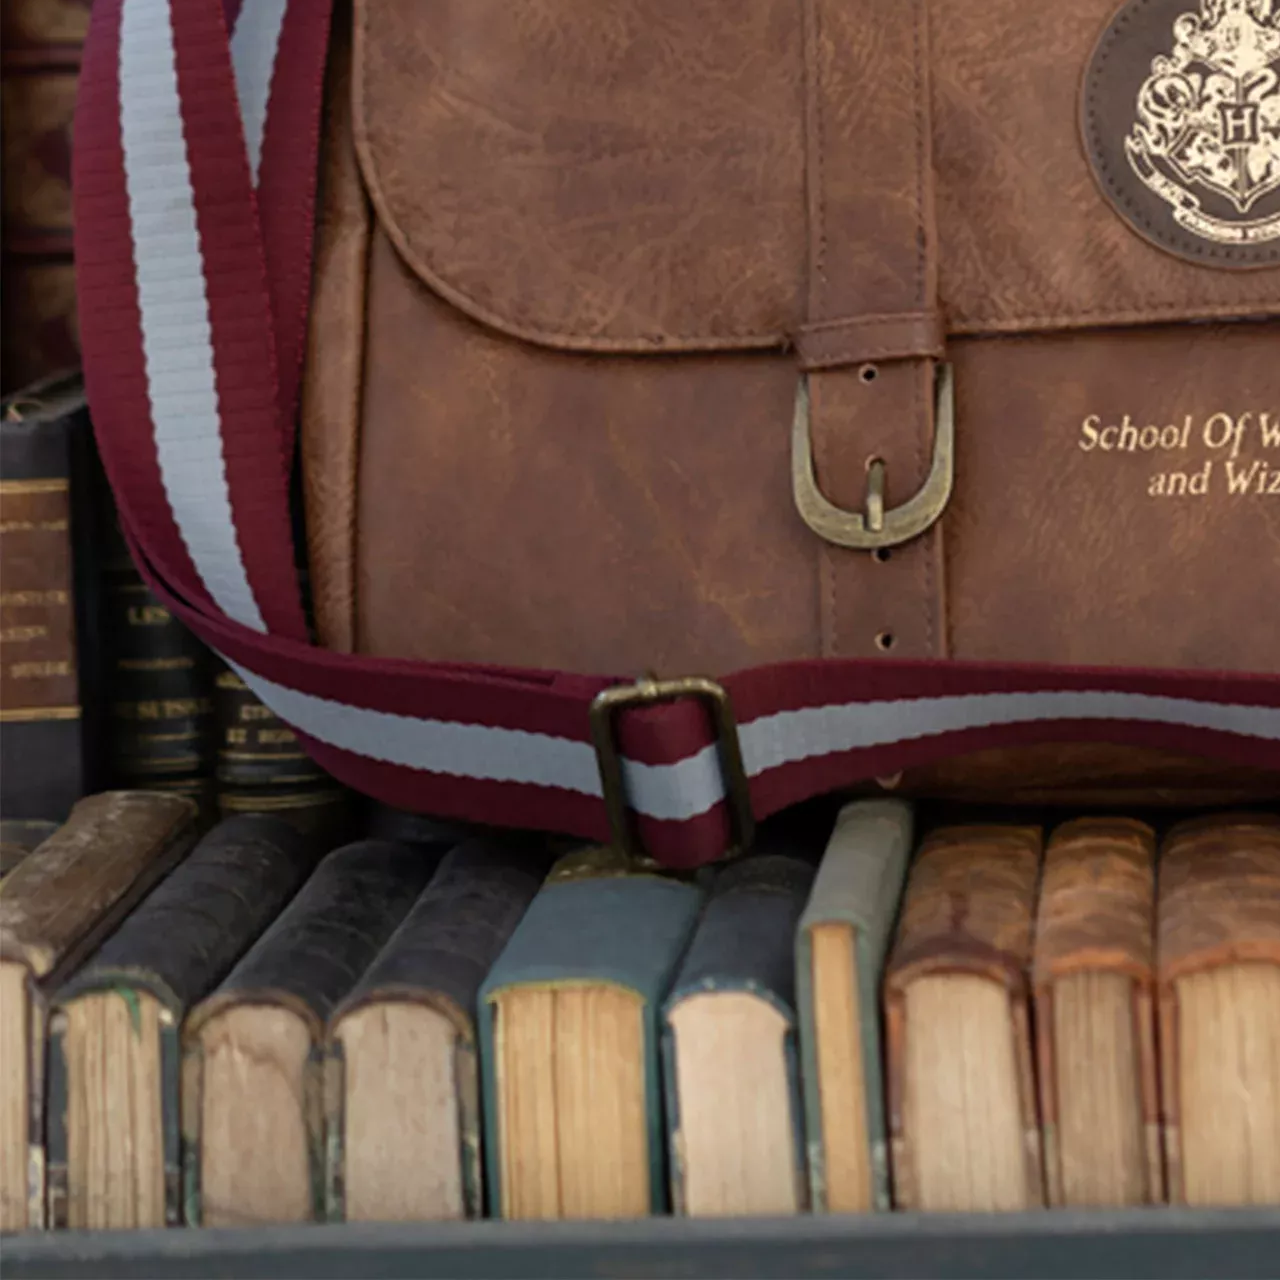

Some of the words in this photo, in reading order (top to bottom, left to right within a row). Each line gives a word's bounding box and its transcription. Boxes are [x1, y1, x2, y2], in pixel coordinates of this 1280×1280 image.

[1225, 108, 1254, 141] H
[1079, 414, 1193, 452] School
[1203, 412, 1252, 458] Of
[1148, 460, 1213, 497] and
